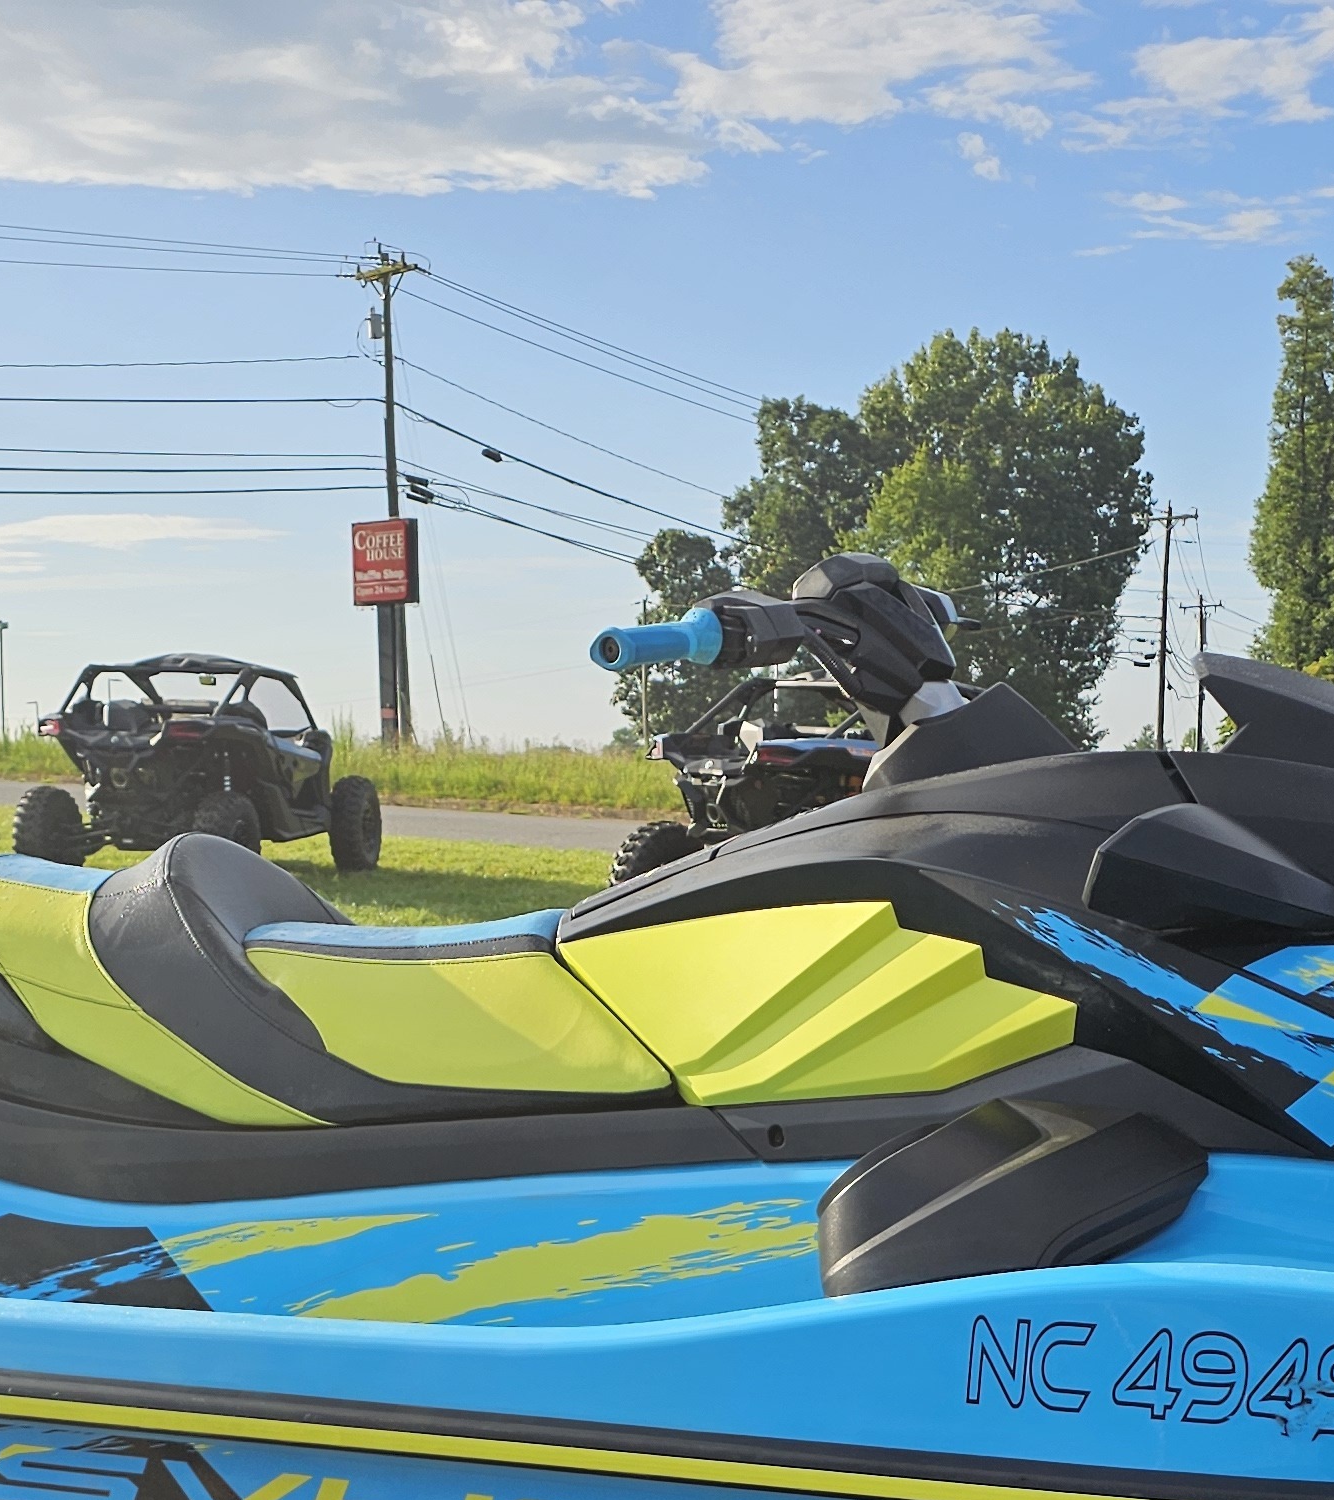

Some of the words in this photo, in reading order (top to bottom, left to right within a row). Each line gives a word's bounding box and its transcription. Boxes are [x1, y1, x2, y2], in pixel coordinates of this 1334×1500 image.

[354, 530, 403, 551] COFFEE
[366, 547, 404, 561] HOUSE
[965, 1314, 1097, 1413] NC
